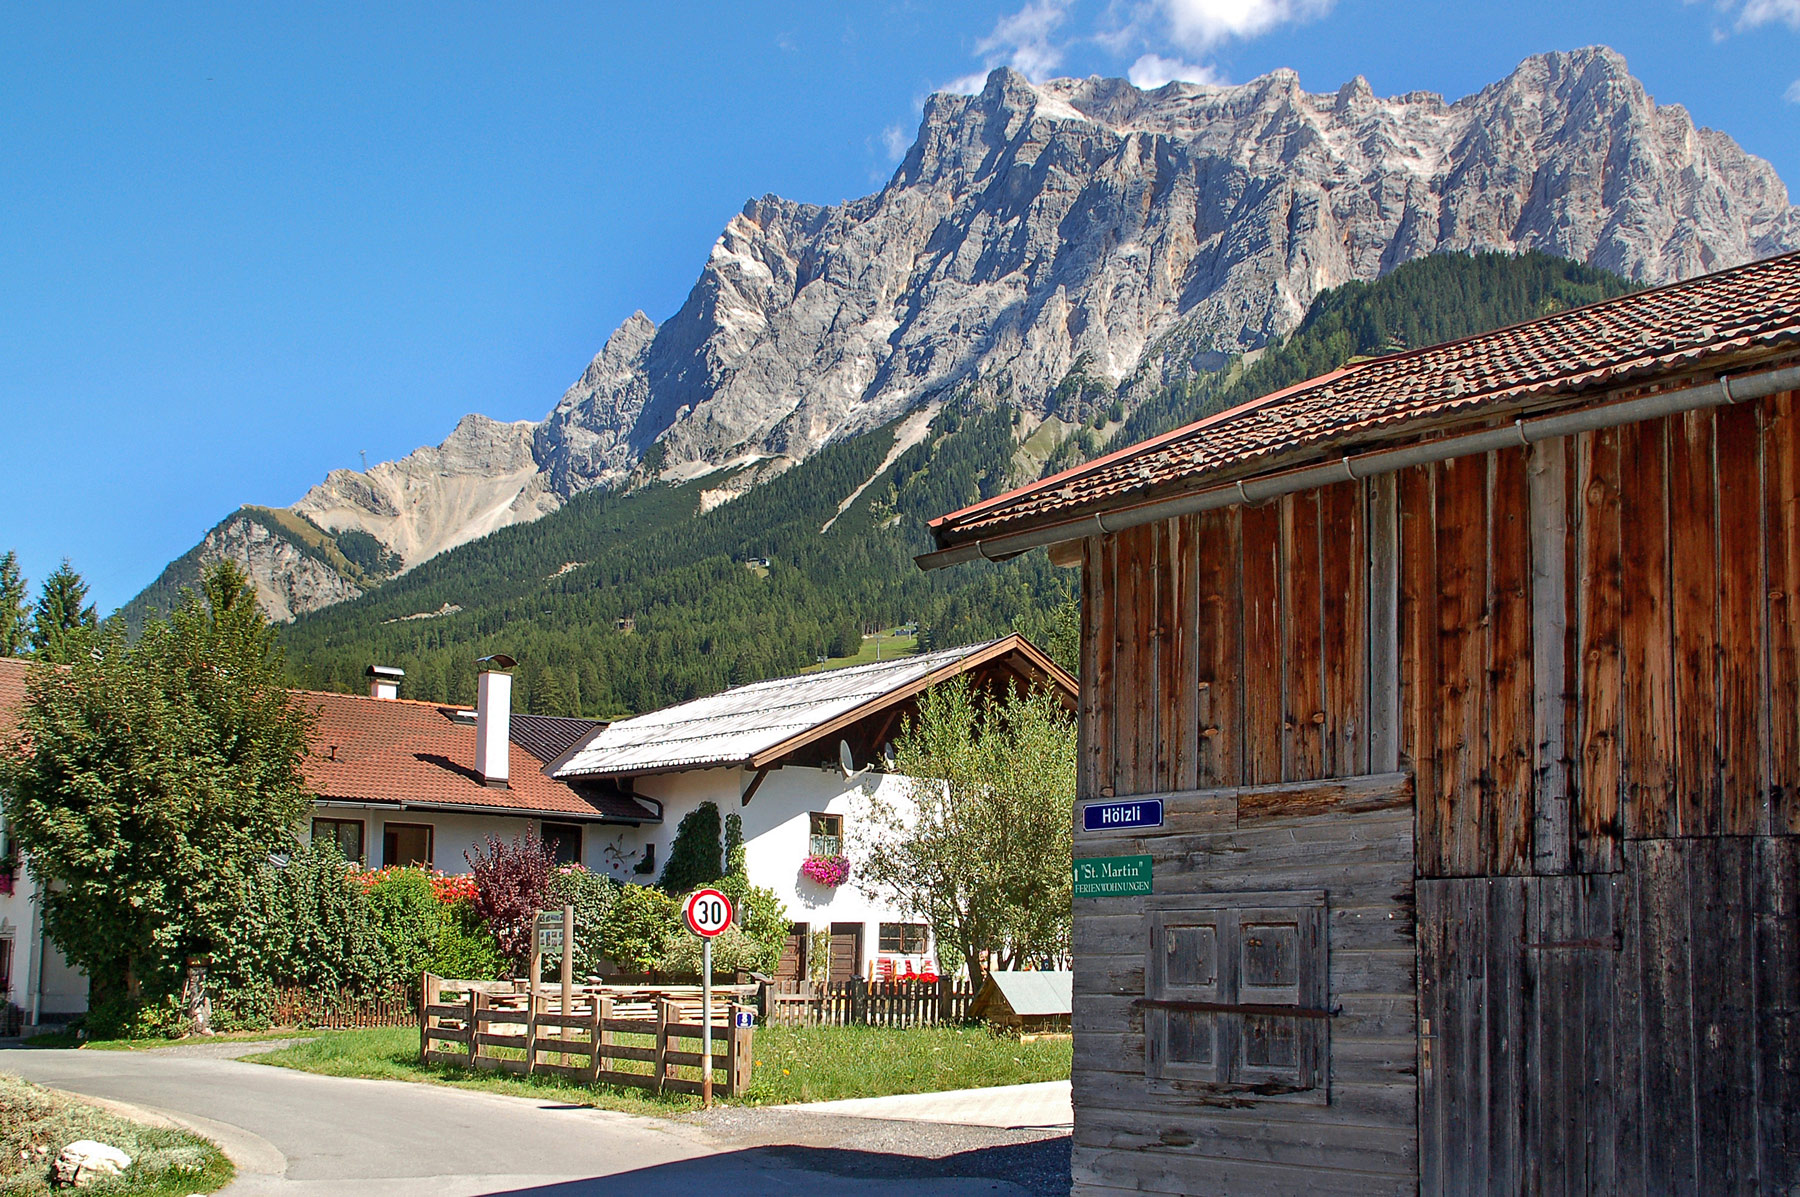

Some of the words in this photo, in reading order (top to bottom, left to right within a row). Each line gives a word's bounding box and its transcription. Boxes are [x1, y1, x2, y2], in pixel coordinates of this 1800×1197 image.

[1102, 805, 1140, 823] Hölzli
[1075, 881, 1149, 893] FERIENWOHNUNGEN
[698, 901, 721, 924] 30
